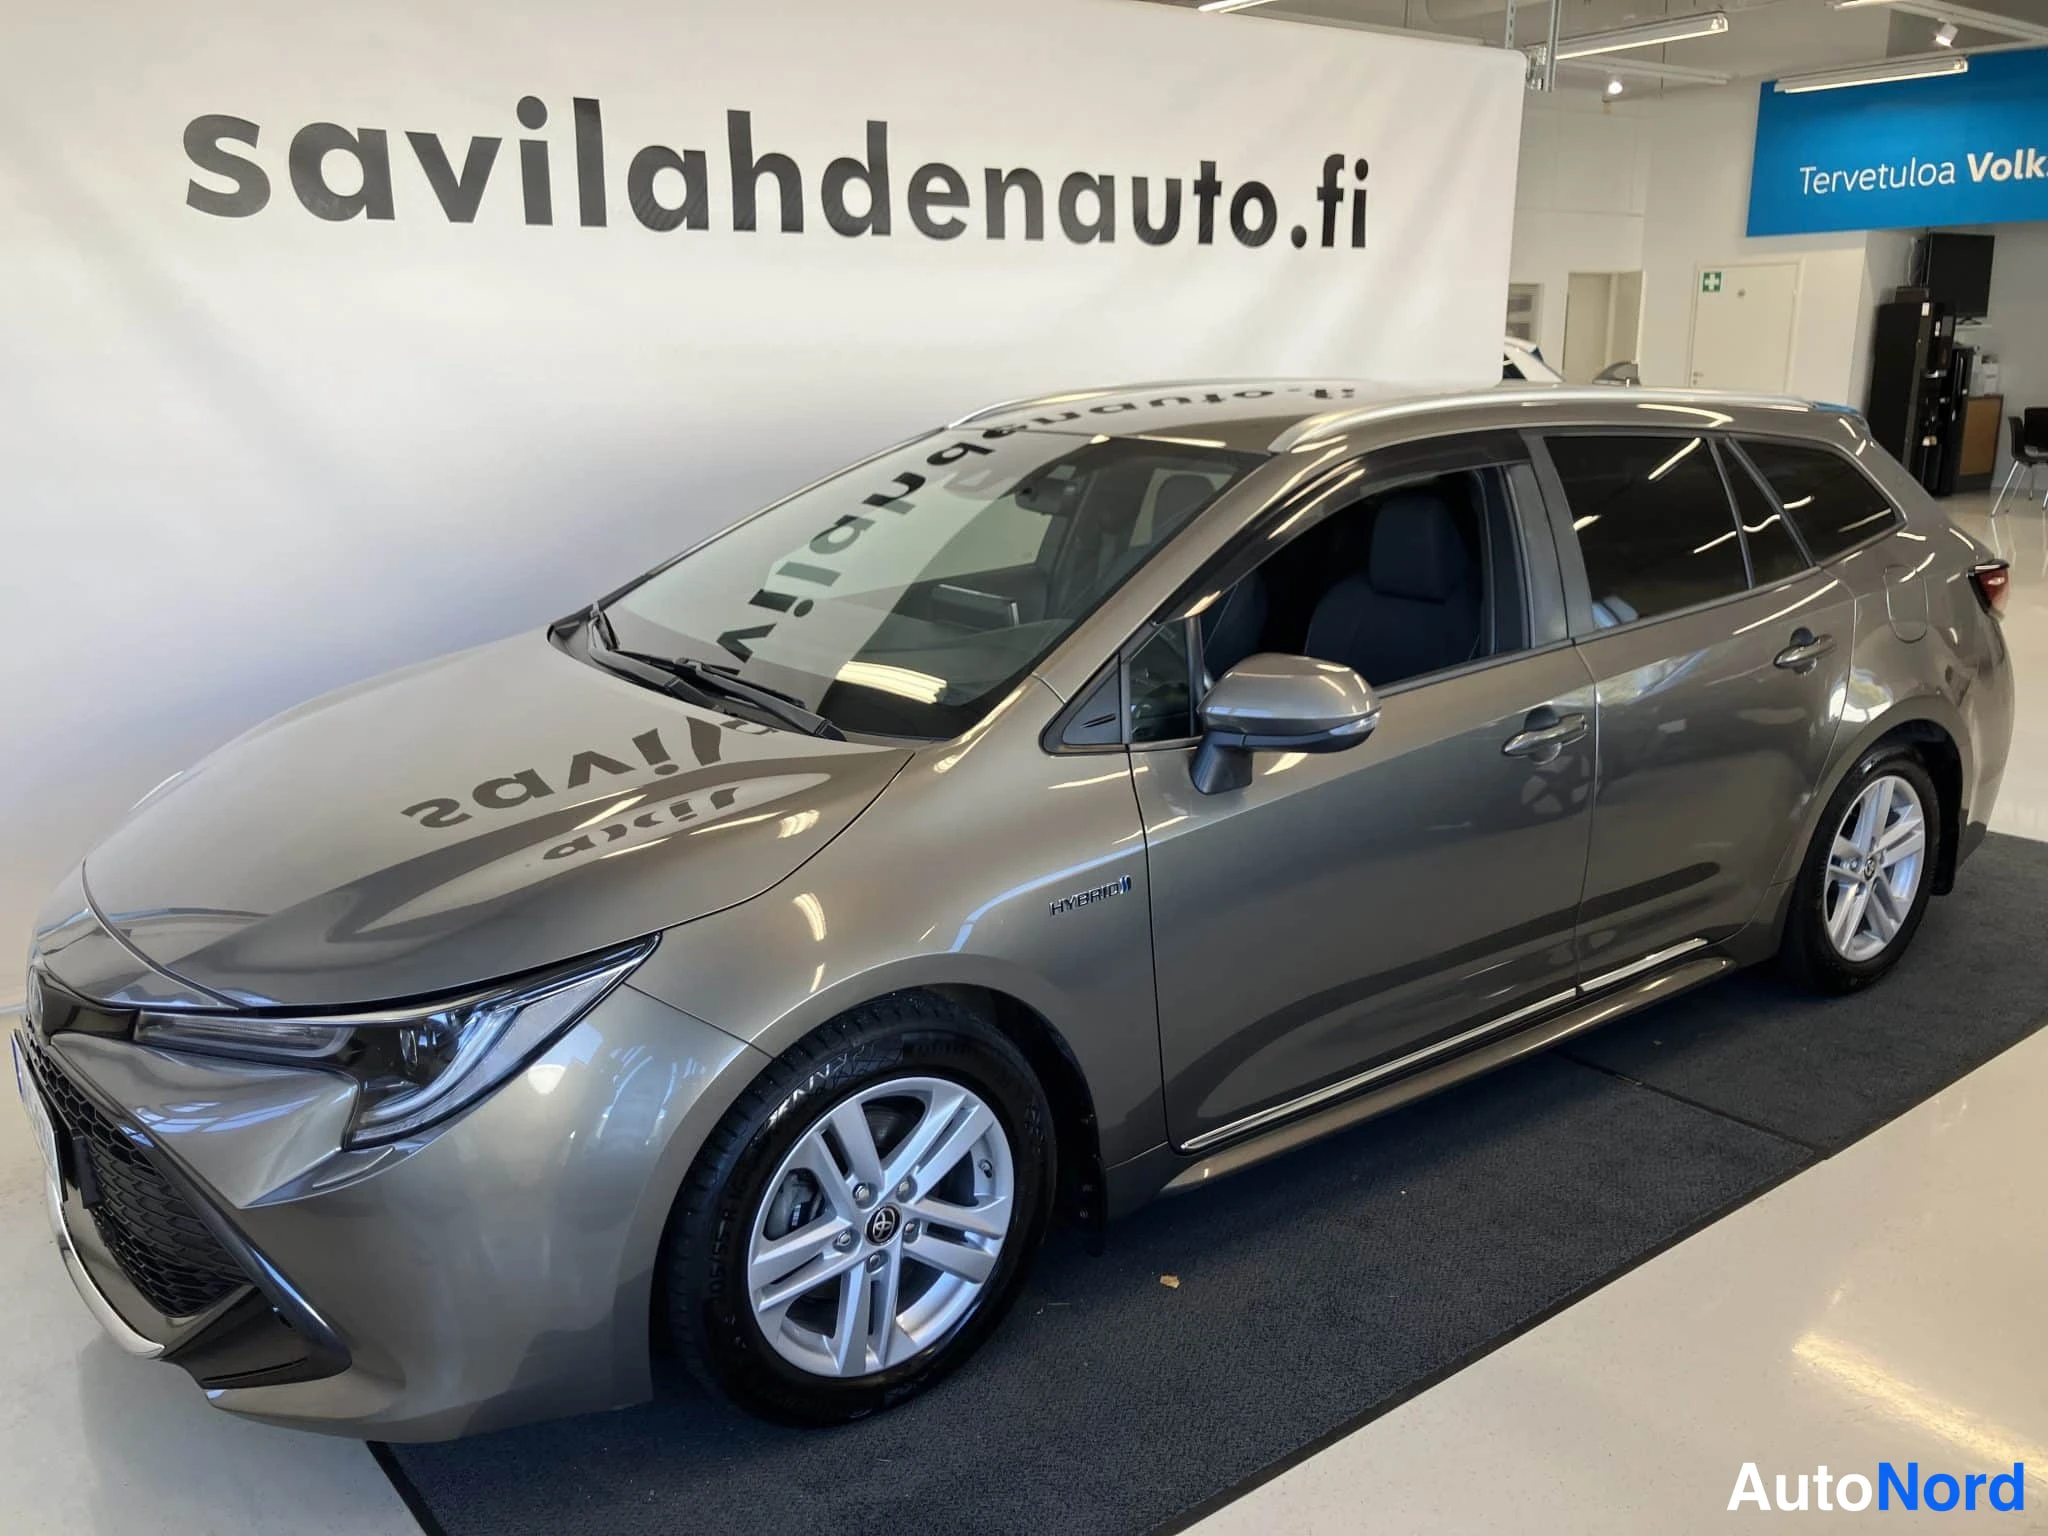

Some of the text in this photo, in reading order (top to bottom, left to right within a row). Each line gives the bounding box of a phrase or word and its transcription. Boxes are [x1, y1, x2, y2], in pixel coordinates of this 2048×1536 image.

[183, 95, 1368, 248] savilahdenauto.fi
[1800, 147, 2048, 195] Tervetuloa Volk
[1049, 882, 1120, 916] HYBRID
